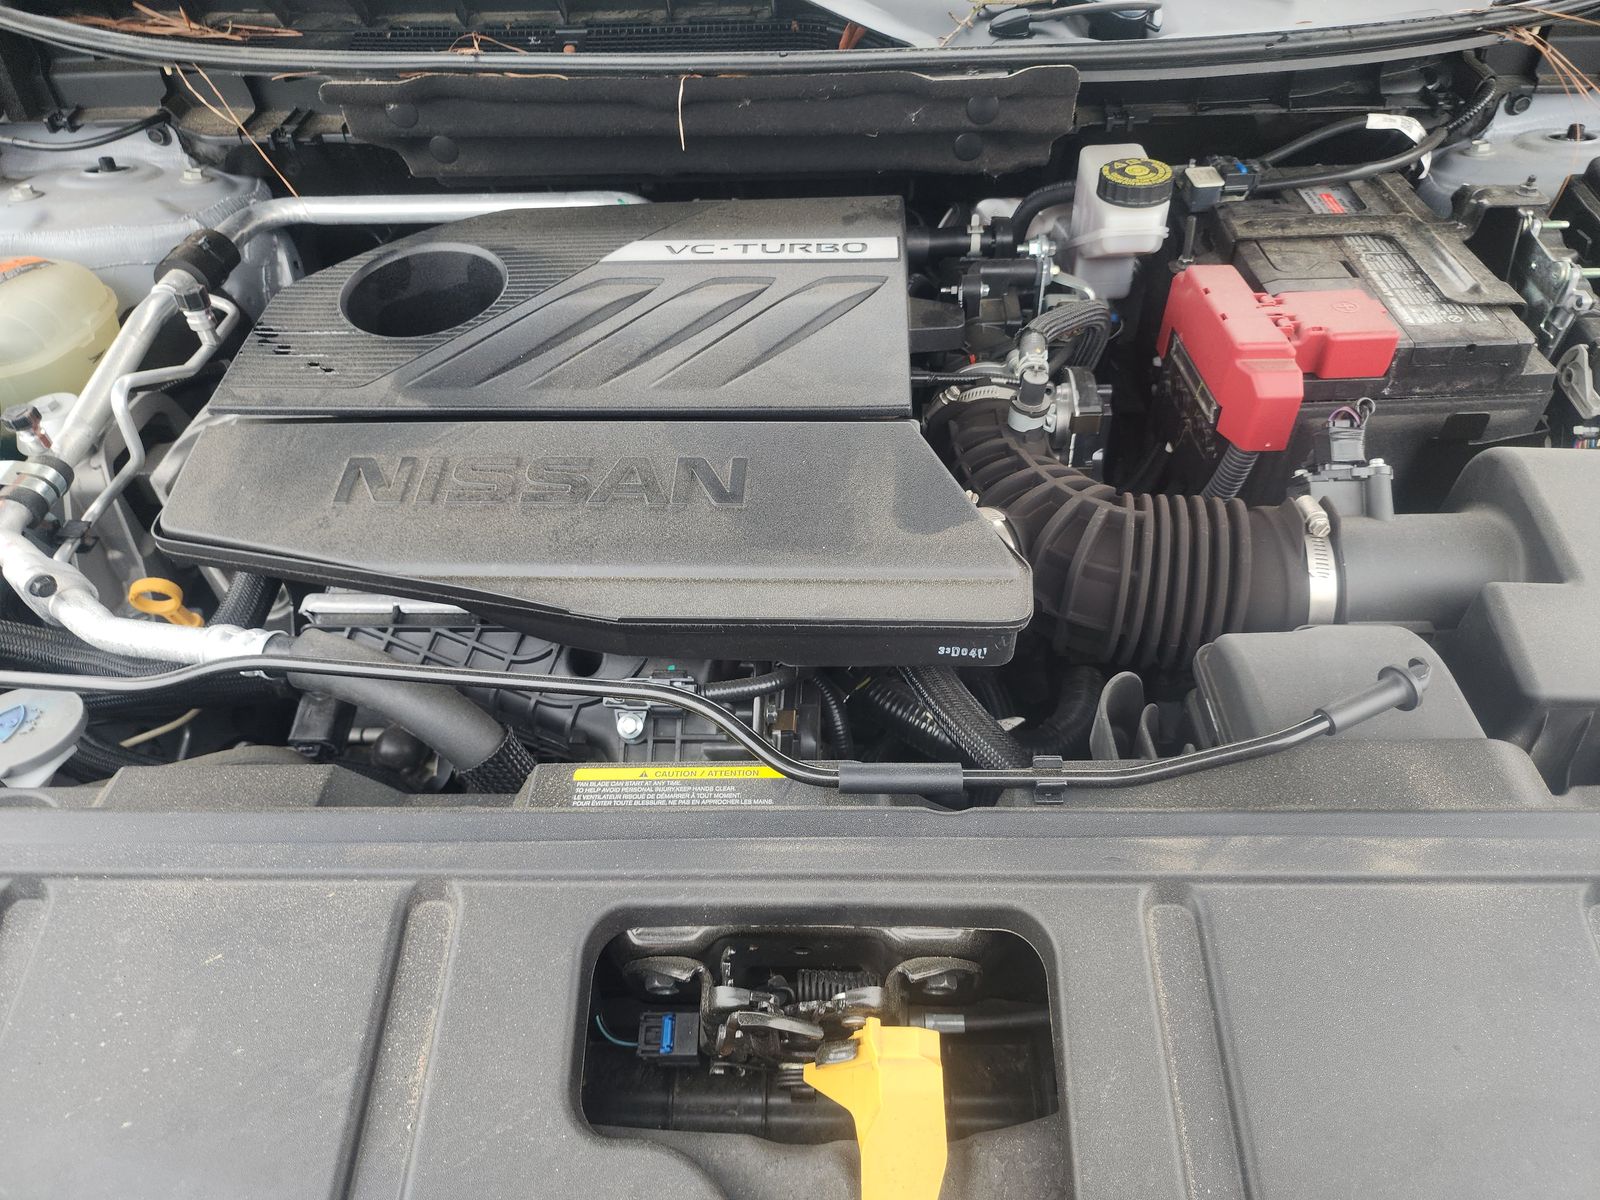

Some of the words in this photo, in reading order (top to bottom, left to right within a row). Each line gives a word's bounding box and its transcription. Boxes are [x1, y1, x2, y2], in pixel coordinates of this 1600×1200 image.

[665, 242, 868, 254] VC-TURBO
[332, 456, 749, 508] NISSAN
[654, 770, 697, 778] CAUTION
[707, 769, 760, 777] ATTENTION
